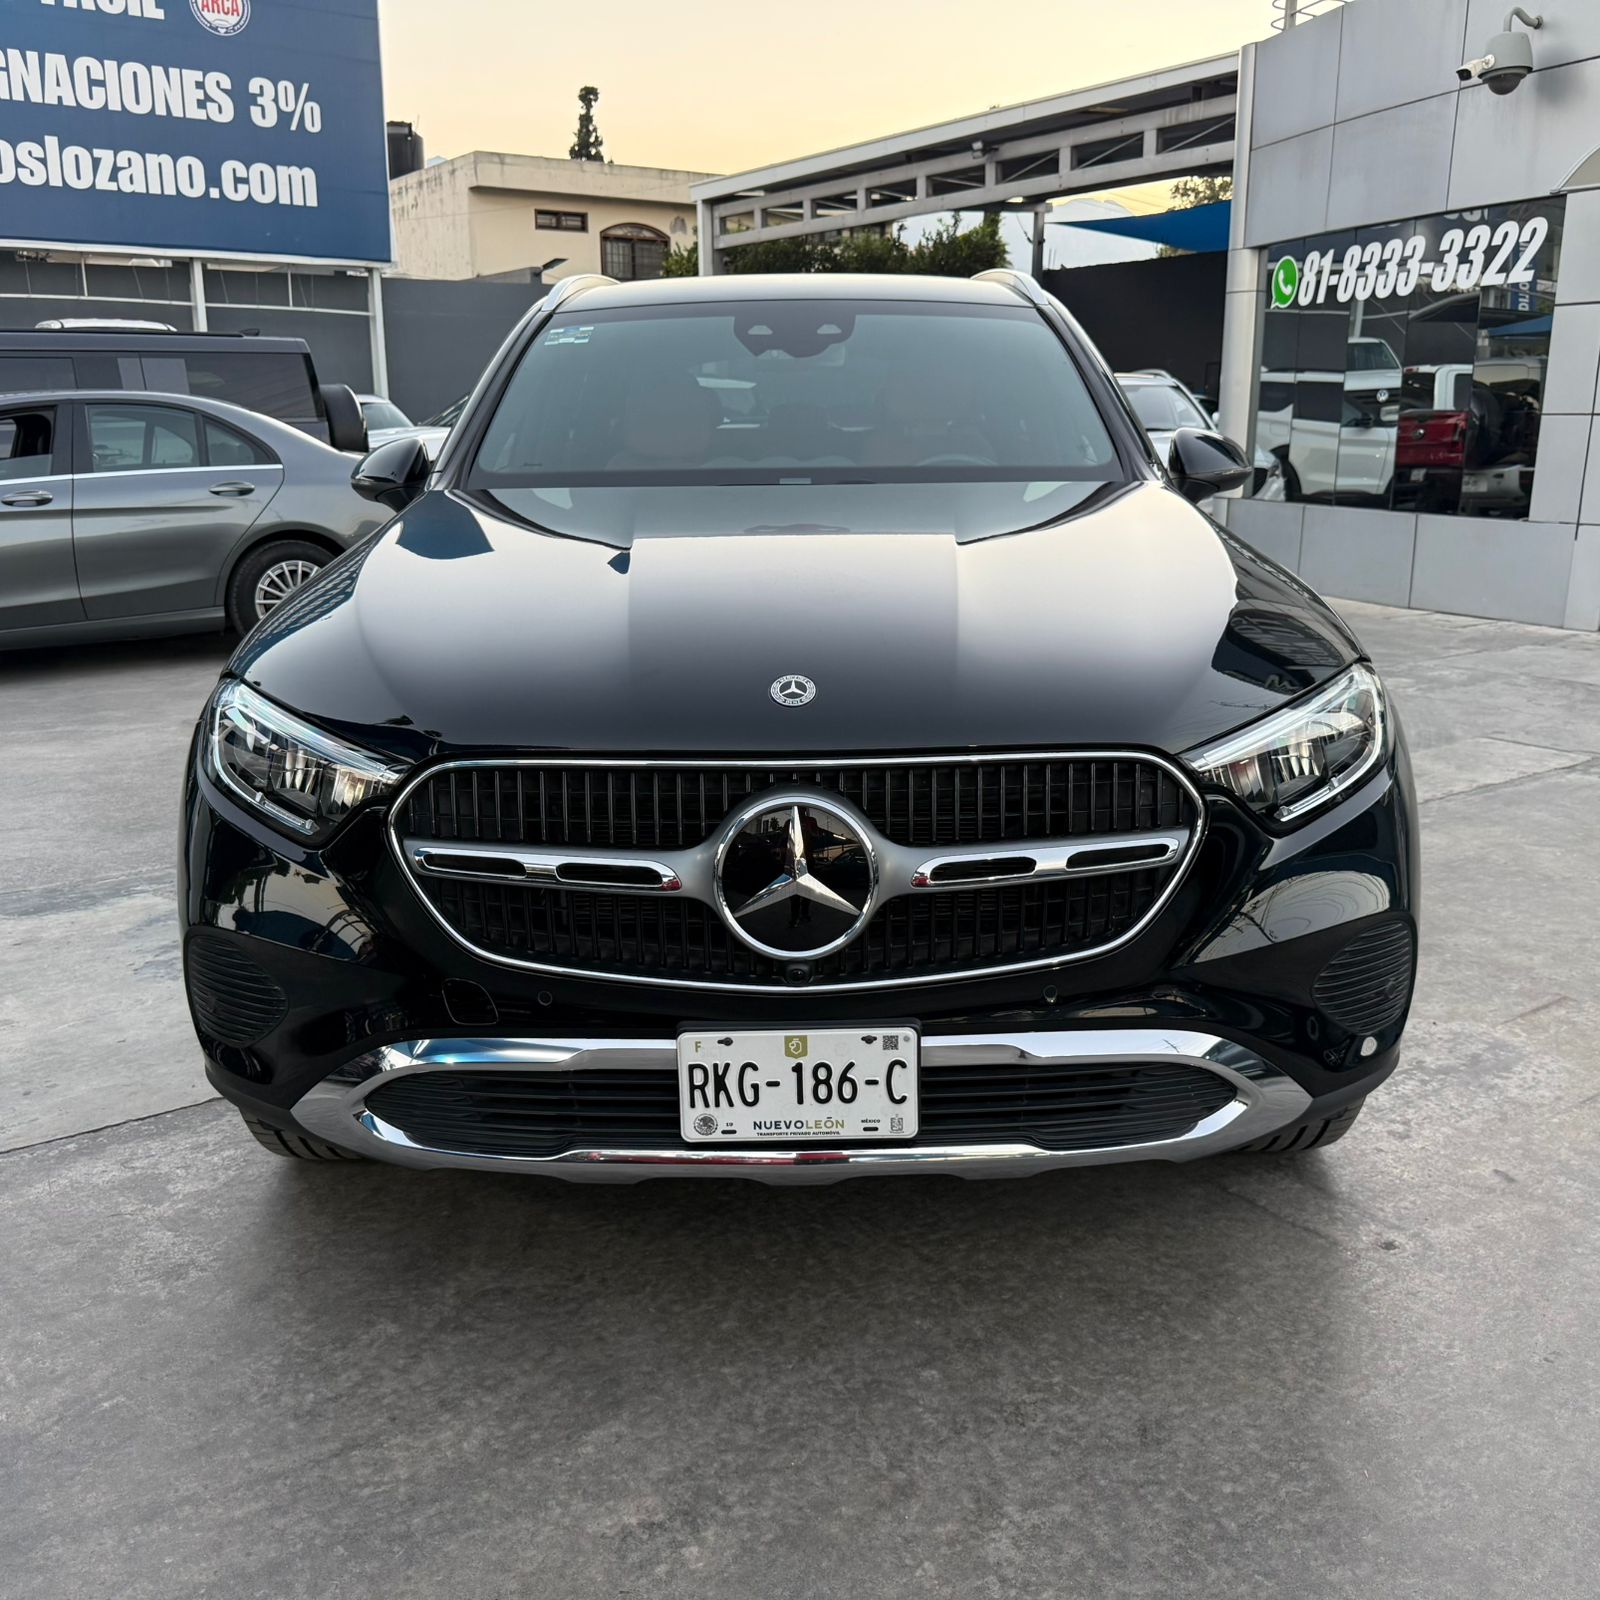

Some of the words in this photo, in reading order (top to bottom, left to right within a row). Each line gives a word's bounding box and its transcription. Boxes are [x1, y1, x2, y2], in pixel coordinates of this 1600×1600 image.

[248, 77, 322, 133] 3%
[1297, 216, 1549, 307] 81-8333-3322
[694, 1040, 702, 1053] F
[688, 1059, 908, 1109] RKG-186-C
